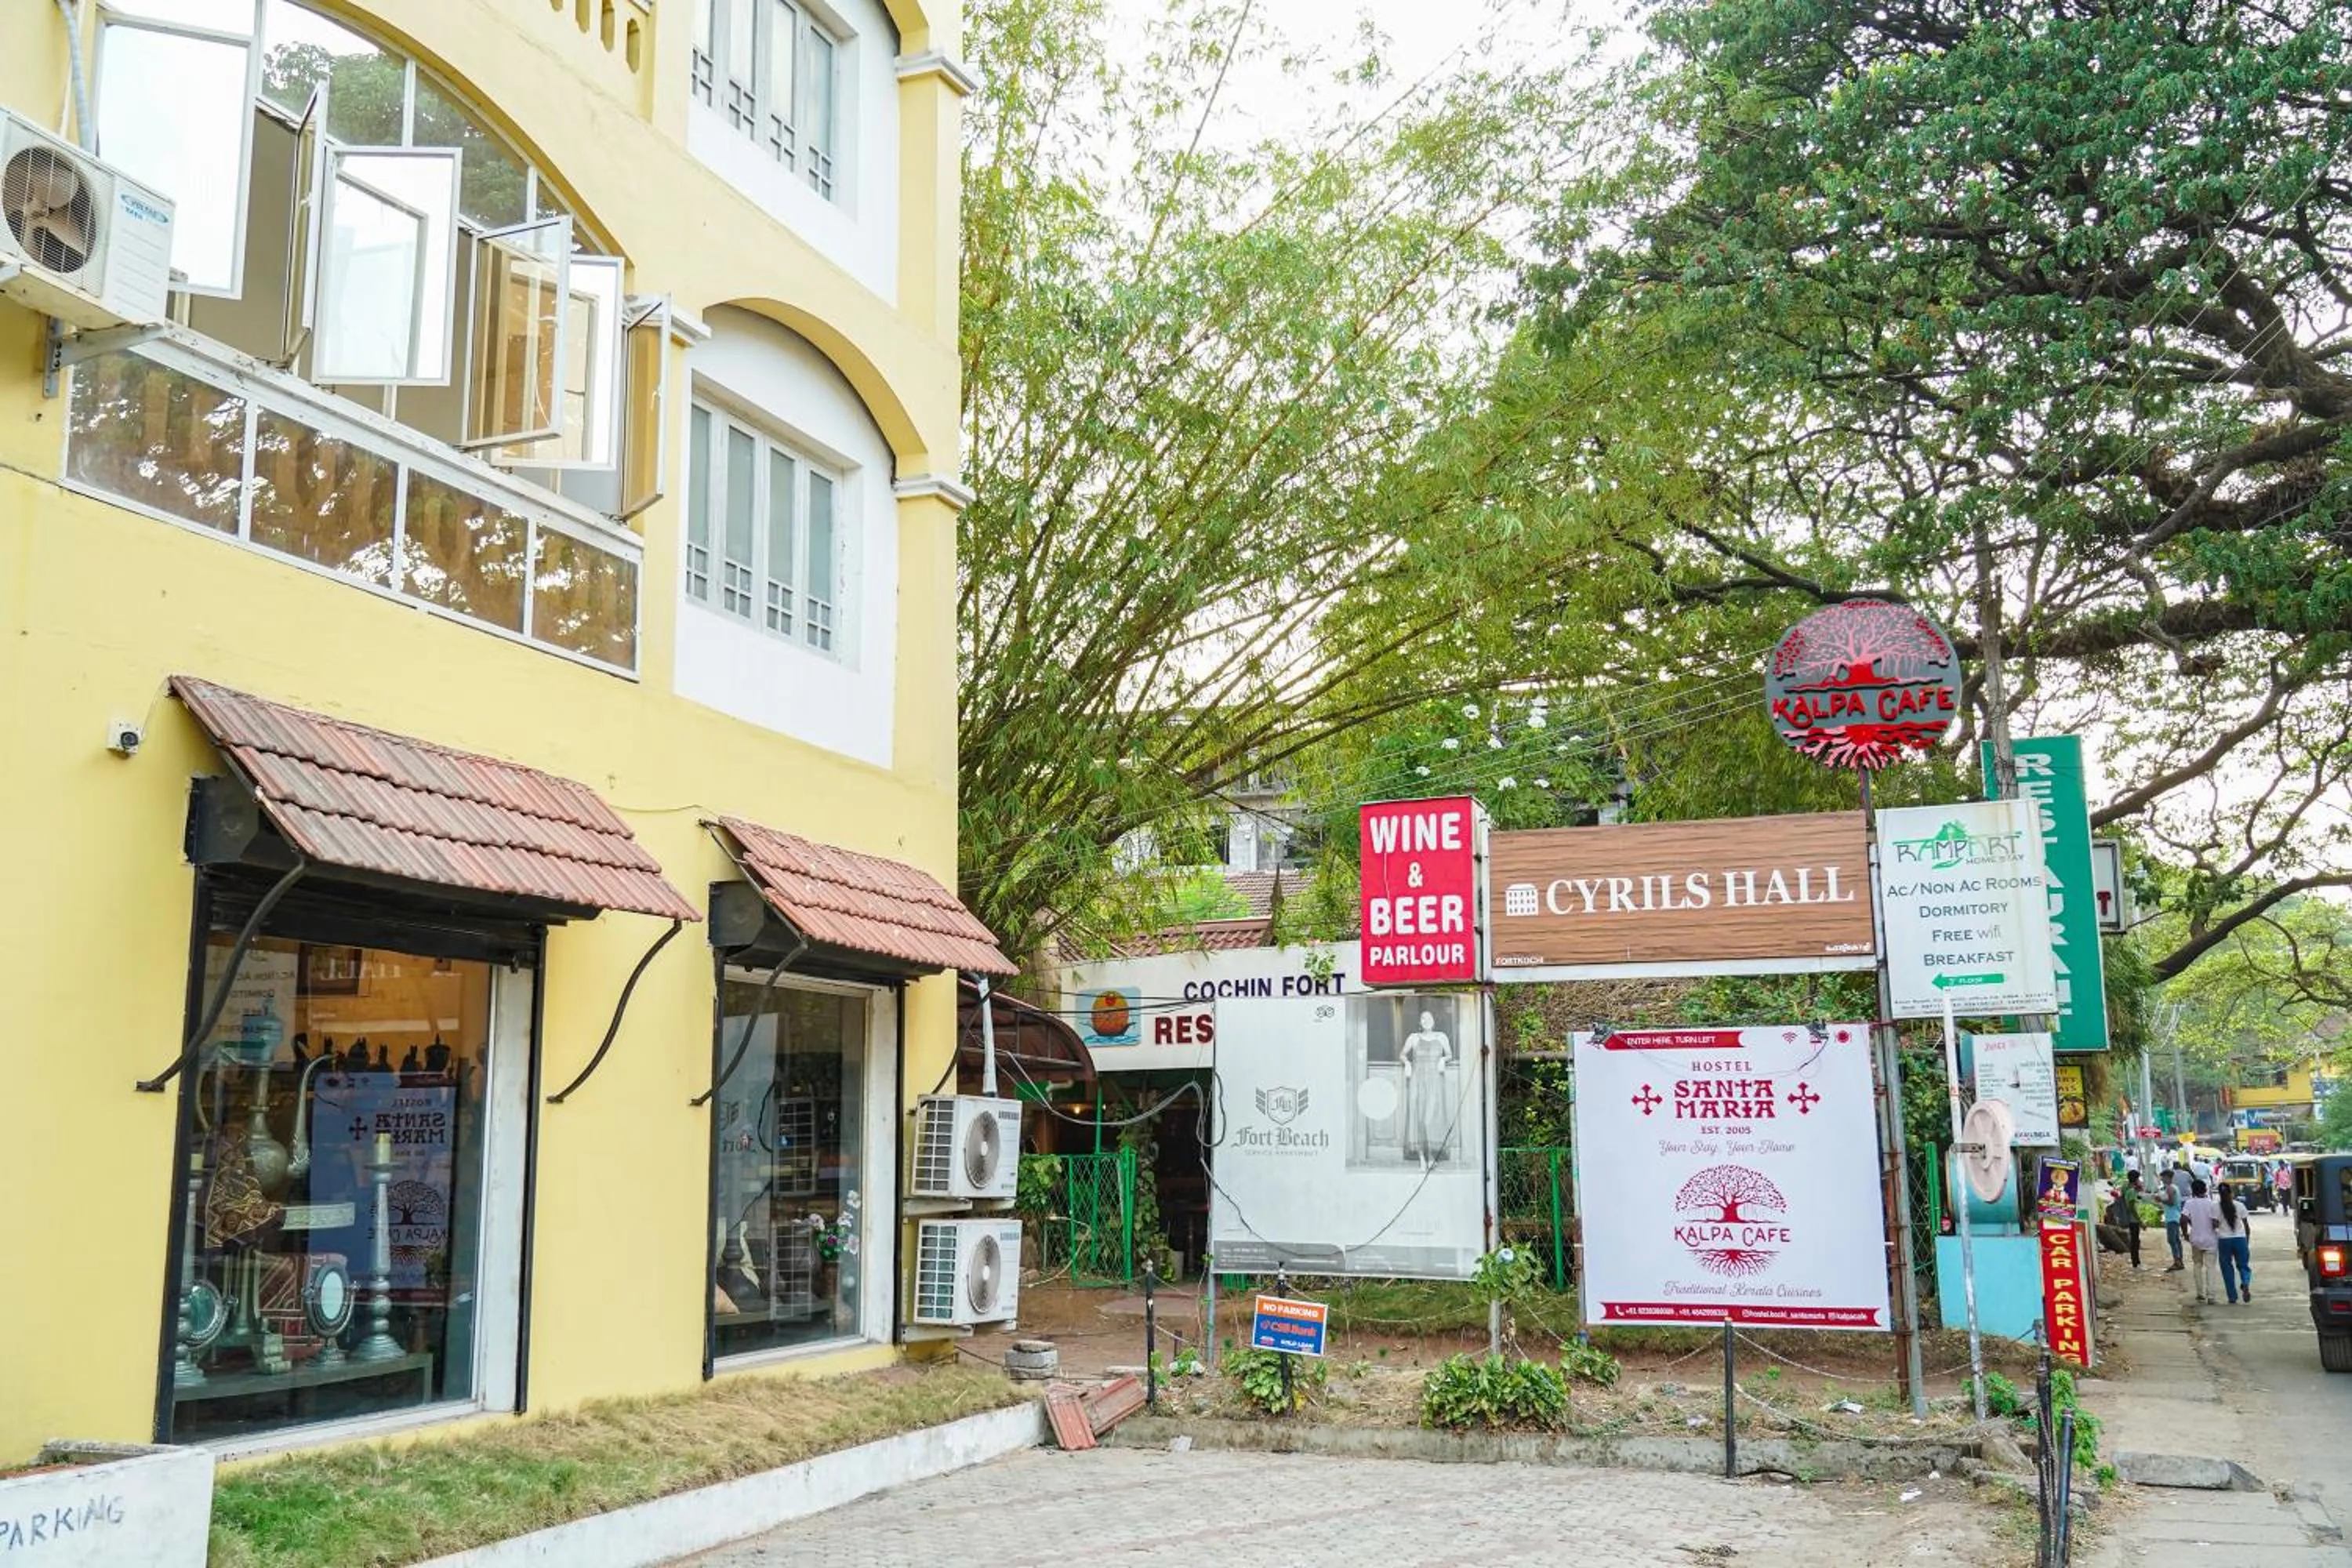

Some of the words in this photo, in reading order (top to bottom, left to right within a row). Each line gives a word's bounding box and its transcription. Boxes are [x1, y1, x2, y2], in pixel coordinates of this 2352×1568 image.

[1772, 691, 1865, 728] KALPA
[1878, 686, 1955, 720] CAFE
[1370, 812, 1461, 854] WINE
[1896, 835, 2020, 863] RAMPART
[1407, 862, 1423, 887] &
[1545, 872, 1712, 916] CYRILS
[1722, 866, 1854, 908] HALL
[1370, 894, 1464, 936] BEER
[1370, 942, 1465, 967] PARLOUR
[1184, 977, 1272, 1000] COCHIN
[1282, 972, 1346, 996] FORT
[1626, 1036, 1651, 1046] ENTER
[1675, 1036, 1697, 1044] TURN
[1697, 1035, 1716, 1044] LEFT
[1692, 1061, 1752, 1072] HOSTEL
[1674, 1079, 1774, 1098] SANTA
[1675, 1100, 1776, 1119] MARIA
[1230, 1126, 1272, 1148] Fort
[1274, 1126, 1329, 1147] Beach
[1726, 1125, 1751, 1134] 2005
[1658, 1140, 1687, 1156] Your
[1726, 1139, 1755, 1156] Your
[1674, 1226, 1733, 1247] KALPA
[1742, 1227, 1791, 1247] CAFE
[2049, 1233, 2072, 1268] CAR
[1664, 1280, 1728, 1297] Traditional
[1730, 1283, 1773, 1298] Kerala
[1776, 1283, 1823, 1298] Cuisines
[1263, 1303, 1276, 1312] NO
[1277, 1305, 1319, 1318] PARKING
[2053, 1279, 2082, 1363] PARKING
